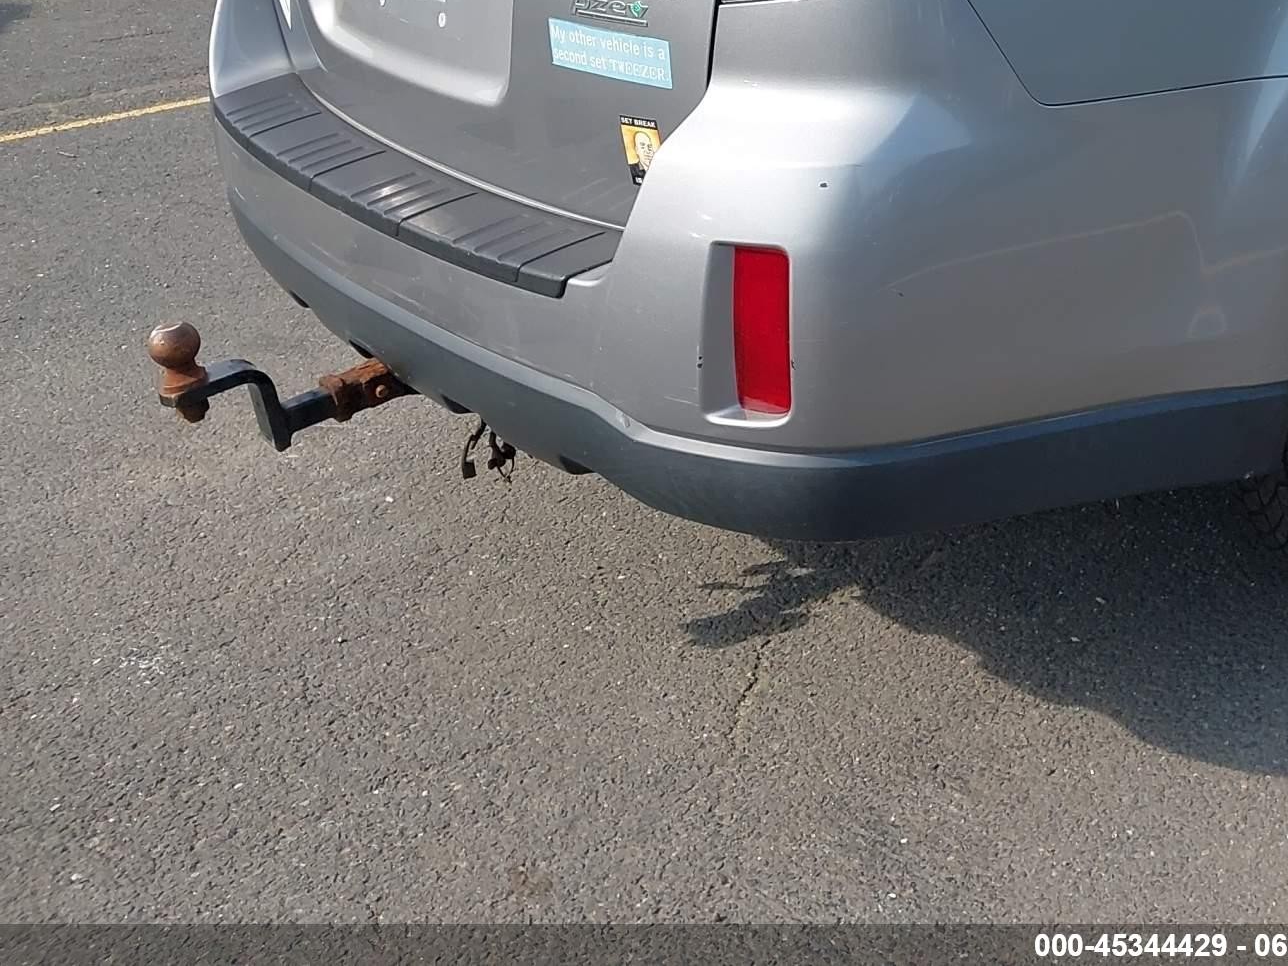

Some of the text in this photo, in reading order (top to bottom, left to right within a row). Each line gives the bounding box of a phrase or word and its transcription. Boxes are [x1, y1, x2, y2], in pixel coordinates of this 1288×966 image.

[550, 24, 666, 60] My other vehicle is a
[553, 47, 588, 66] second
[590, 54, 608, 71] set
[634, 119, 656, 128] BREAK
